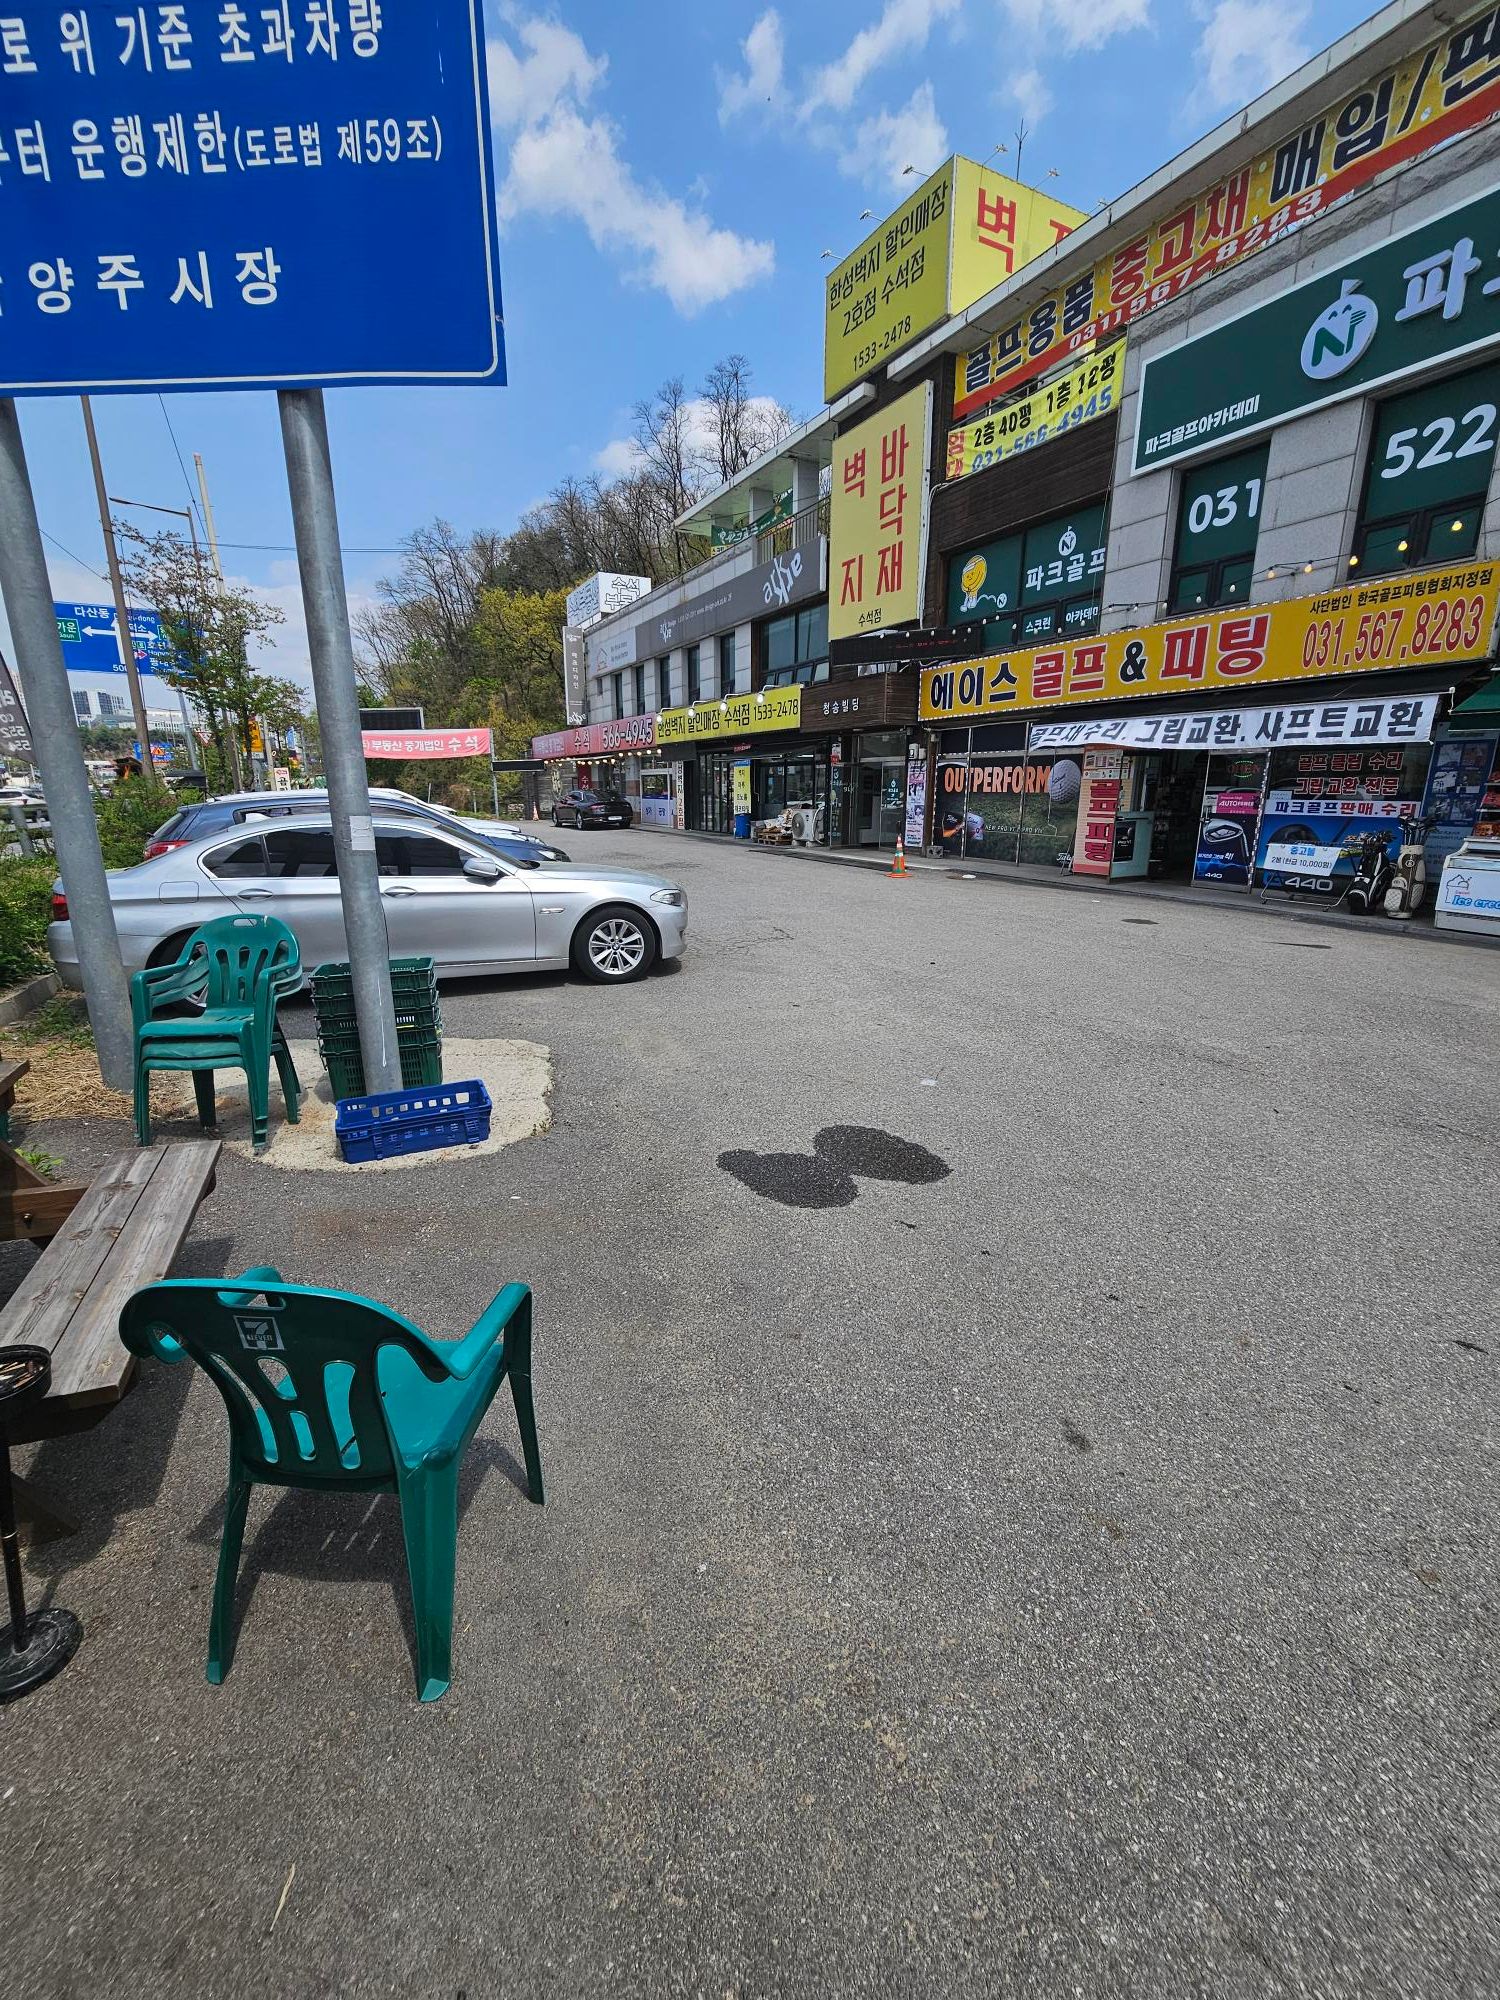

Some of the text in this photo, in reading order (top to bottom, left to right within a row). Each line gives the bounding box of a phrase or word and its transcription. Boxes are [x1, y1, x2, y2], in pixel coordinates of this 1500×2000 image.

[60, 10, 96, 76] 위
[115, 5, 192, 73] 기준
[218, 0, 383, 63] 초과차량
[0, 110, 442, 182] 터 운행제한(도로법 제59조)
[830, 181, 949, 311] 한성벽지 할인매장
[842, 246, 925, 338] 2호점 수석점
[1395, 237, 1500, 322] 파
[853, 315, 911, 372] 1533-2478
[966, 272, 1095, 394] 골프용품
[974, 352, 1116, 448] 2층 40평 1층 12평
[1145, 394, 1260, 455] 파크골프아카데미
[971, 386, 1113, 473] 031-566-4945
[1380, 403, 1497, 479] 522
[1188, 478, 1261, 534] 031
[1025, 547, 1106, 591] 파크골프
[1310, 567, 1493, 614] 사단법인 한국골프피팅협회지정점
[74, 606, 109, 619] 다산동
[858, 607, 882, 627] 수석점
[1025, 617, 1050, 633] 스크린
[1301, 594, 1485, 669] 031.567.8283
[931, 613, 1271, 711] 에이스 골프 & 피팅
[725, 703, 750, 728] 수석점
[754, 698, 799, 722] 1533-2478
[823, 698, 859, 715] 청송빌딩
[1255, 700, 1423, 741] 샤프트교환
[372, 740, 402, 751] 부동산
[405, 740, 444, 751] 중개법인
[603, 717, 653, 750] 566-4945
[944, 765, 1051, 794] OUTPERFORM
[1294, 778, 1324, 795] 그립
[1326, 777, 1360, 795] 교환
[1365, 777, 1399, 795] 전문
[1299, 751, 1404, 771] 골프 클럽 수리
[1452, 895, 1472, 907] Ice
